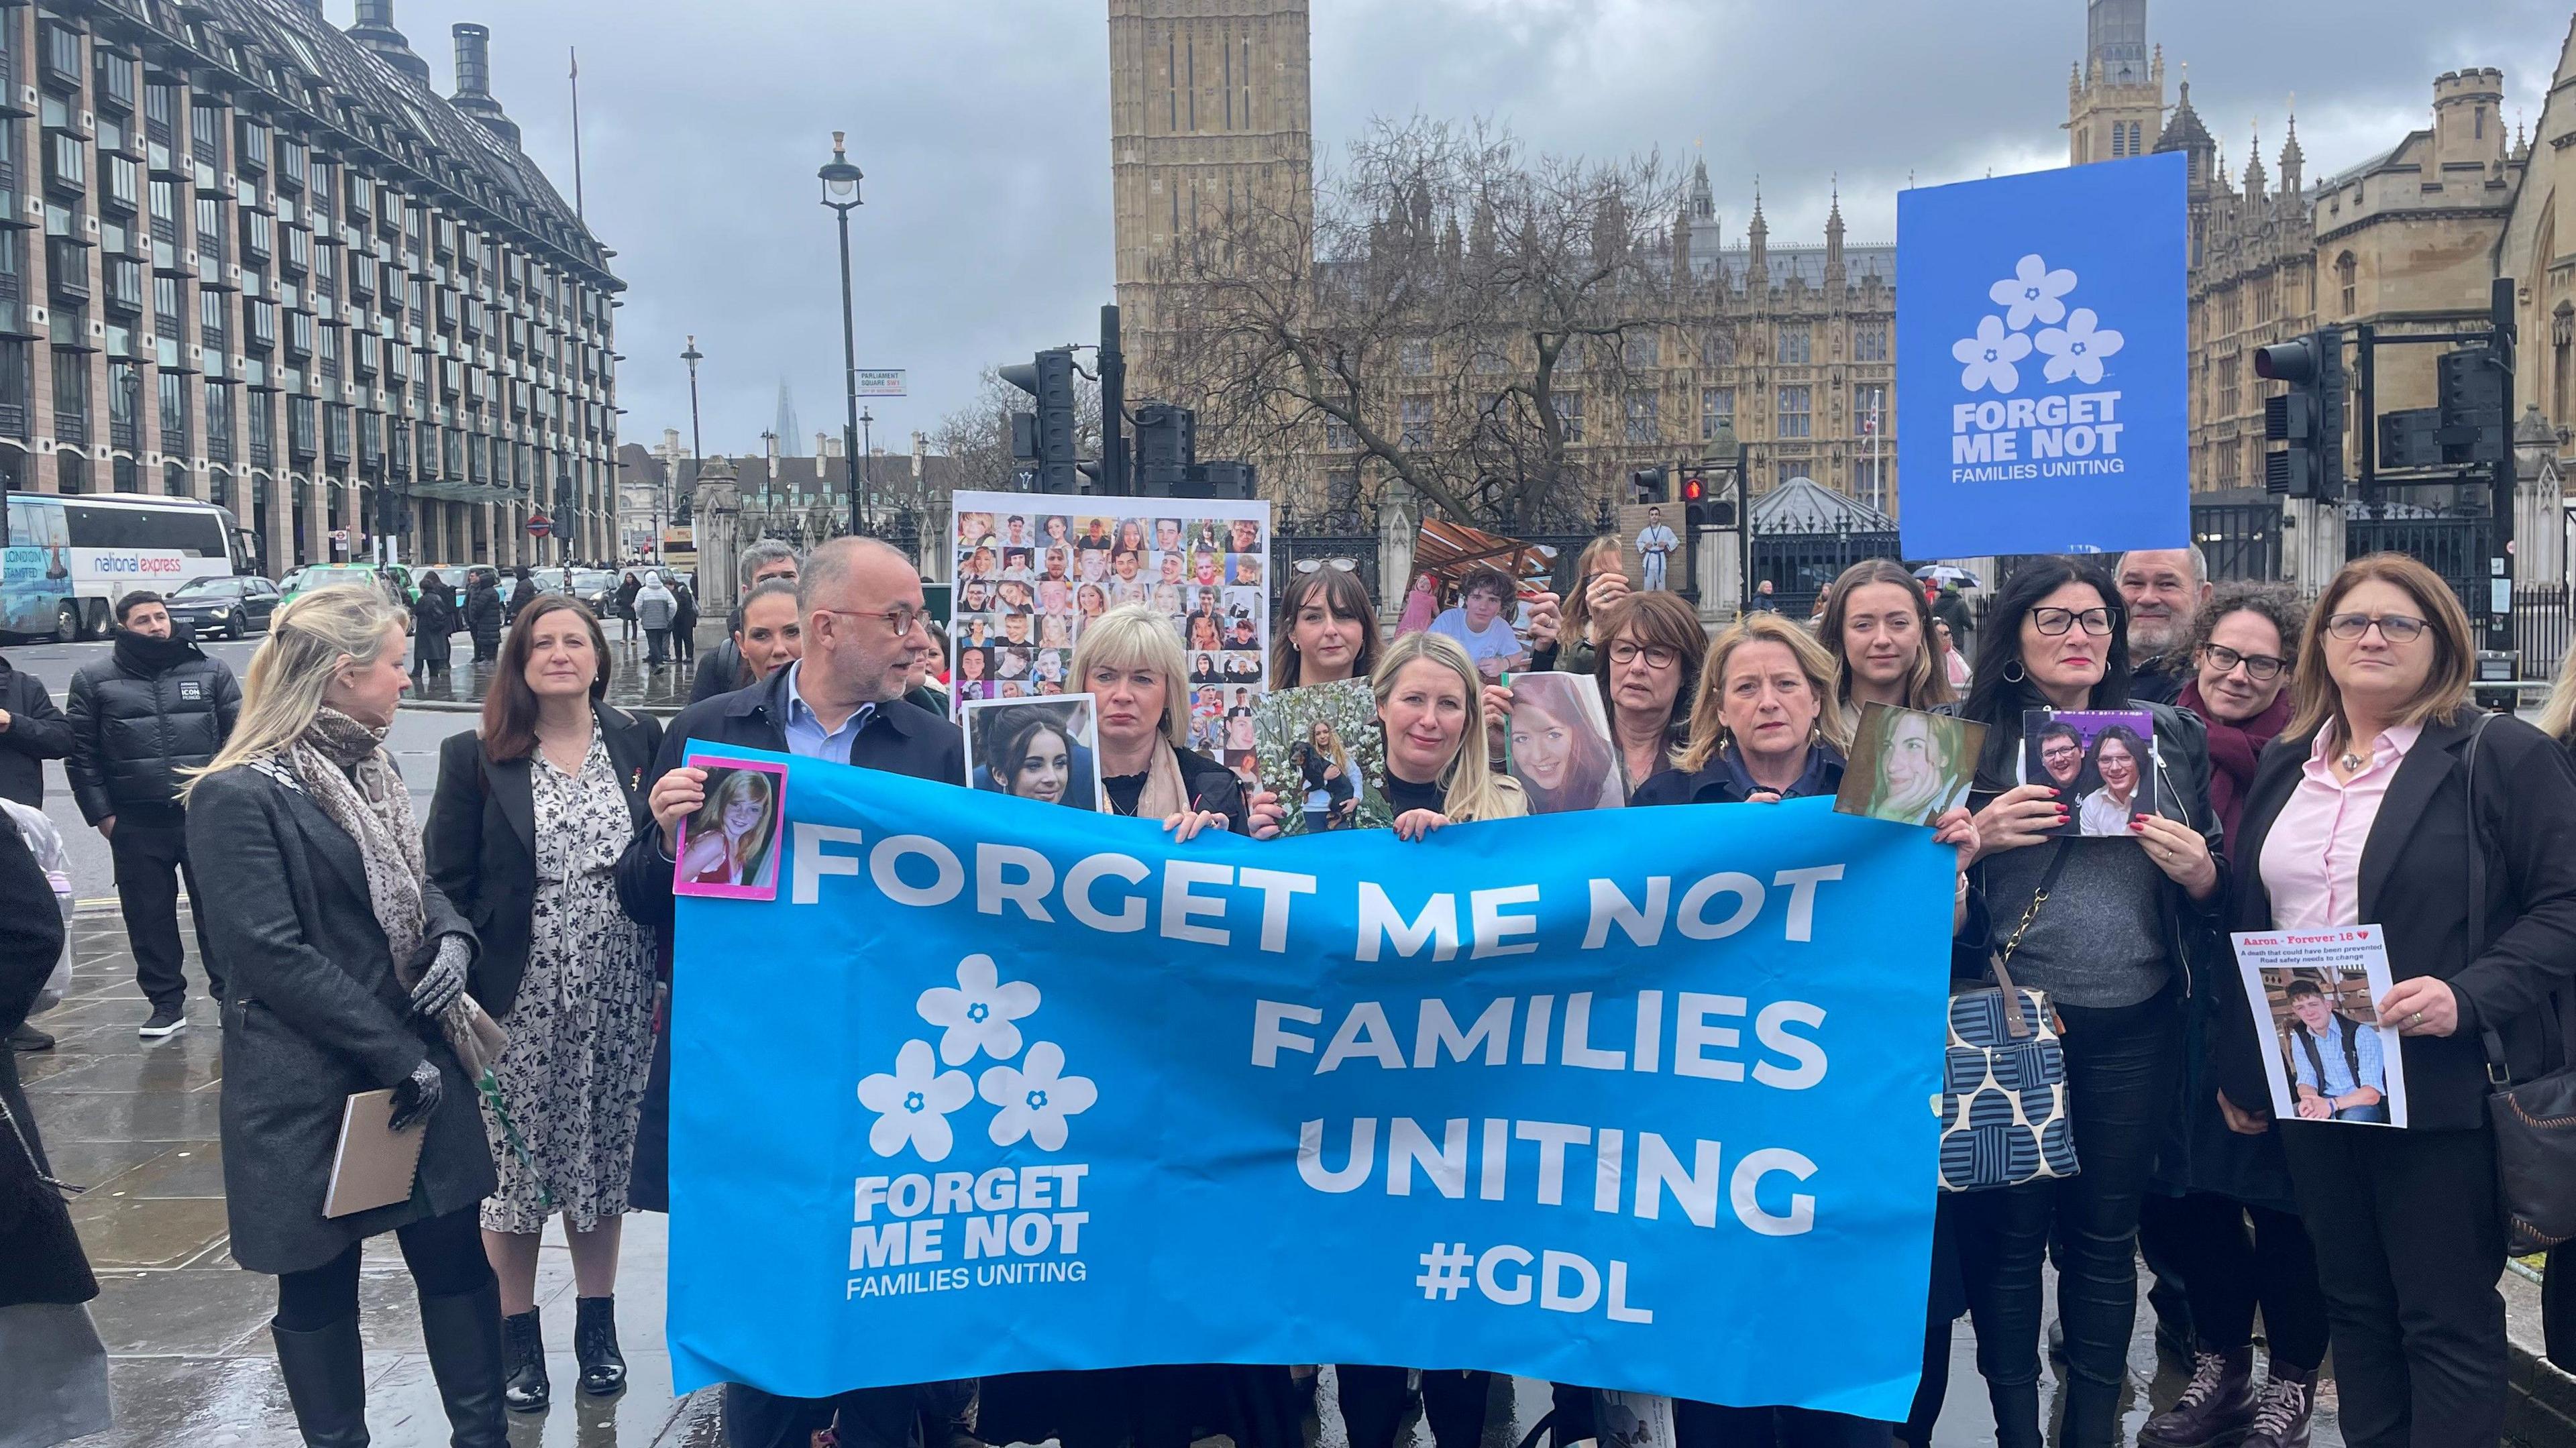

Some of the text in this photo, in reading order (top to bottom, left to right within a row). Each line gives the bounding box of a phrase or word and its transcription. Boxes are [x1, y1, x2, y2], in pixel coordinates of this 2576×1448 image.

[1953, 392, 2121, 433] FORGET
[1953, 424, 2123, 464] ME NOT
[1953, 459, 2124, 483] FAMILIES UNITING
[5, 551, 42, 563] LONDON
[95, 552, 181, 577] national express
[792, 822, 1845, 962] FORGET ME NOT
[2243, 938, 2277, 946] Aaron
[2287, 934, 2334, 944] Forever
[2339, 932, 2354, 941] 18
[2344, 944, 2382, 953] prevented
[1252, 990, 1827, 1090] FAMILIES
[854, 1164, 1089, 1222] FORGET
[1297, 1117, 1819, 1236] UNITING
[849, 1212, 1089, 1270] ME NOT
[847, 1262, 1086, 1300] FAMILIES UNITING
[1416, 1243, 1653, 1324] #GDL
